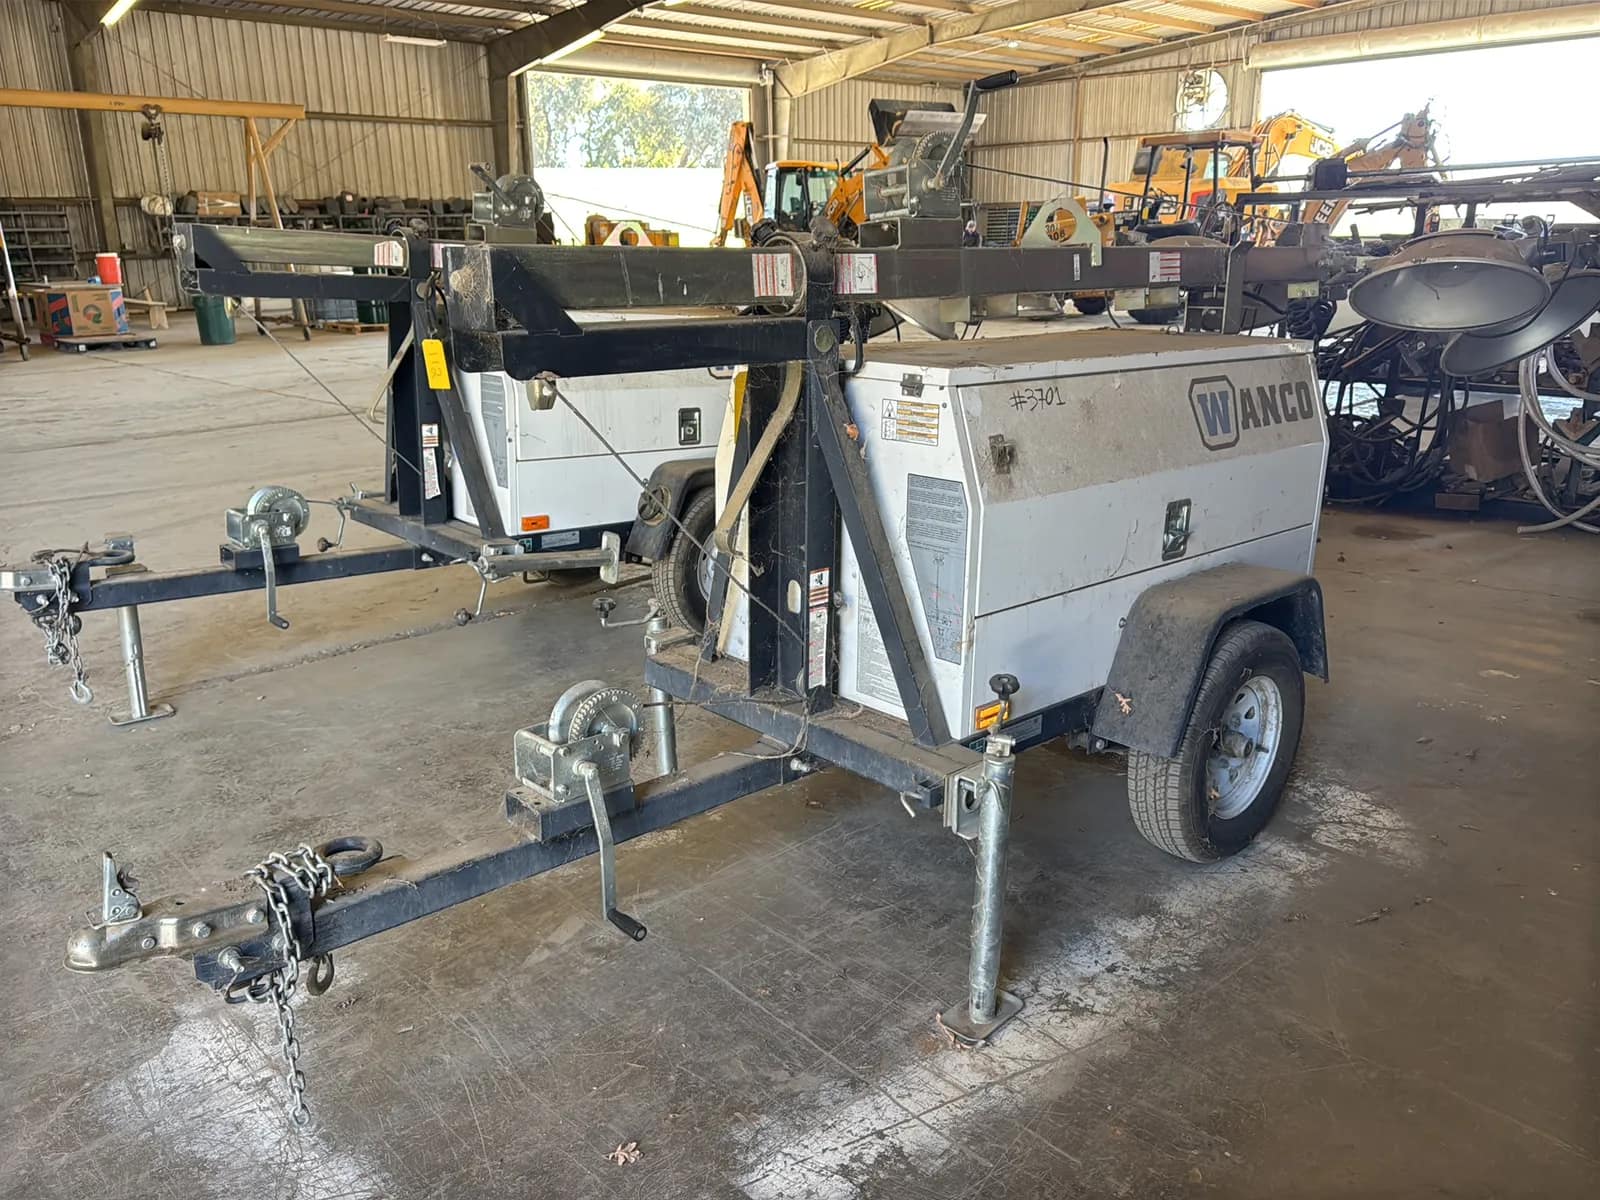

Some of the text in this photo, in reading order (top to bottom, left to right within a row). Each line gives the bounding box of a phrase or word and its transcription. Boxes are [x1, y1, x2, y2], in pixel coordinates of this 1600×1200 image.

[1310, 136, 1334, 157] JCB
[1009, 386, 1066, 411] #3701
[1197, 381, 1314, 437] WANCO
